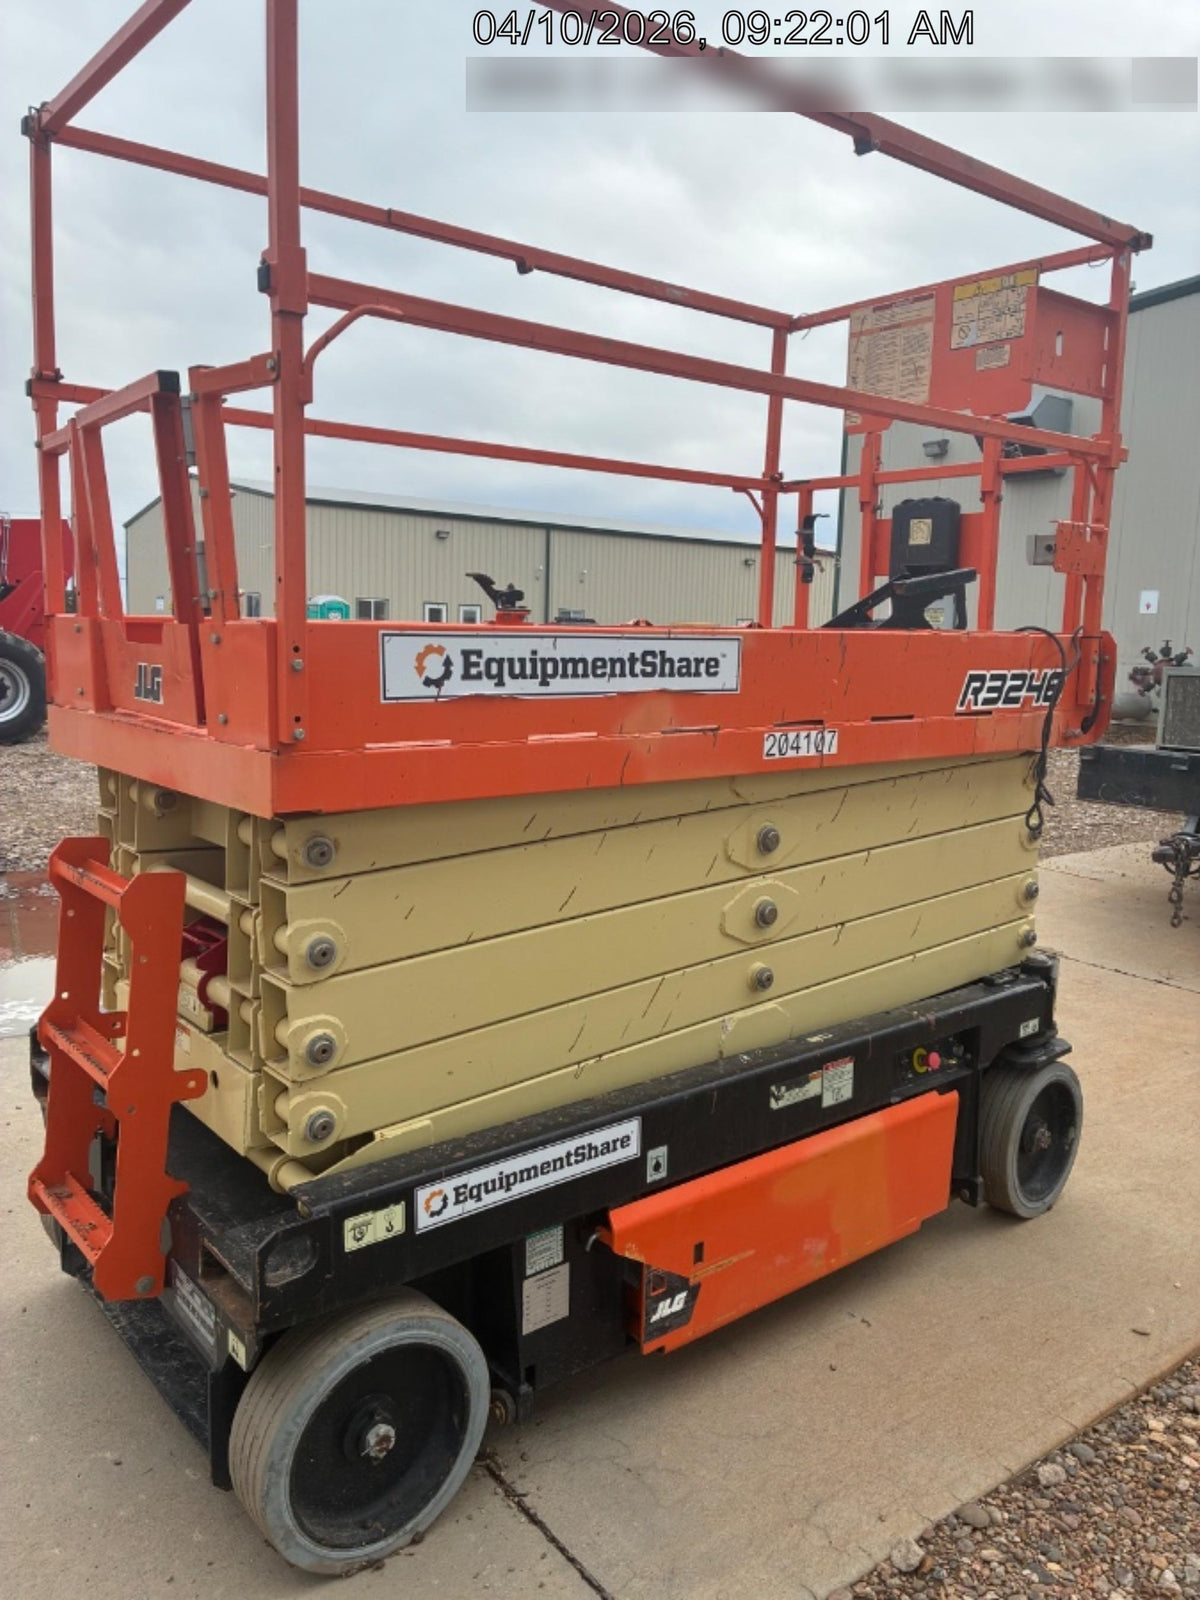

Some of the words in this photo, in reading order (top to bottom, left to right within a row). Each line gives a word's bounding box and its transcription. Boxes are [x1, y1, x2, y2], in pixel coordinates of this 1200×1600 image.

[134, 662, 163, 704] JLG
[460, 649, 720, 687] EquipmentShare
[764, 730, 837, 758] 204107
[452, 1132, 632, 1206] EquipmentShare
[650, 1291, 688, 1323] JLG
